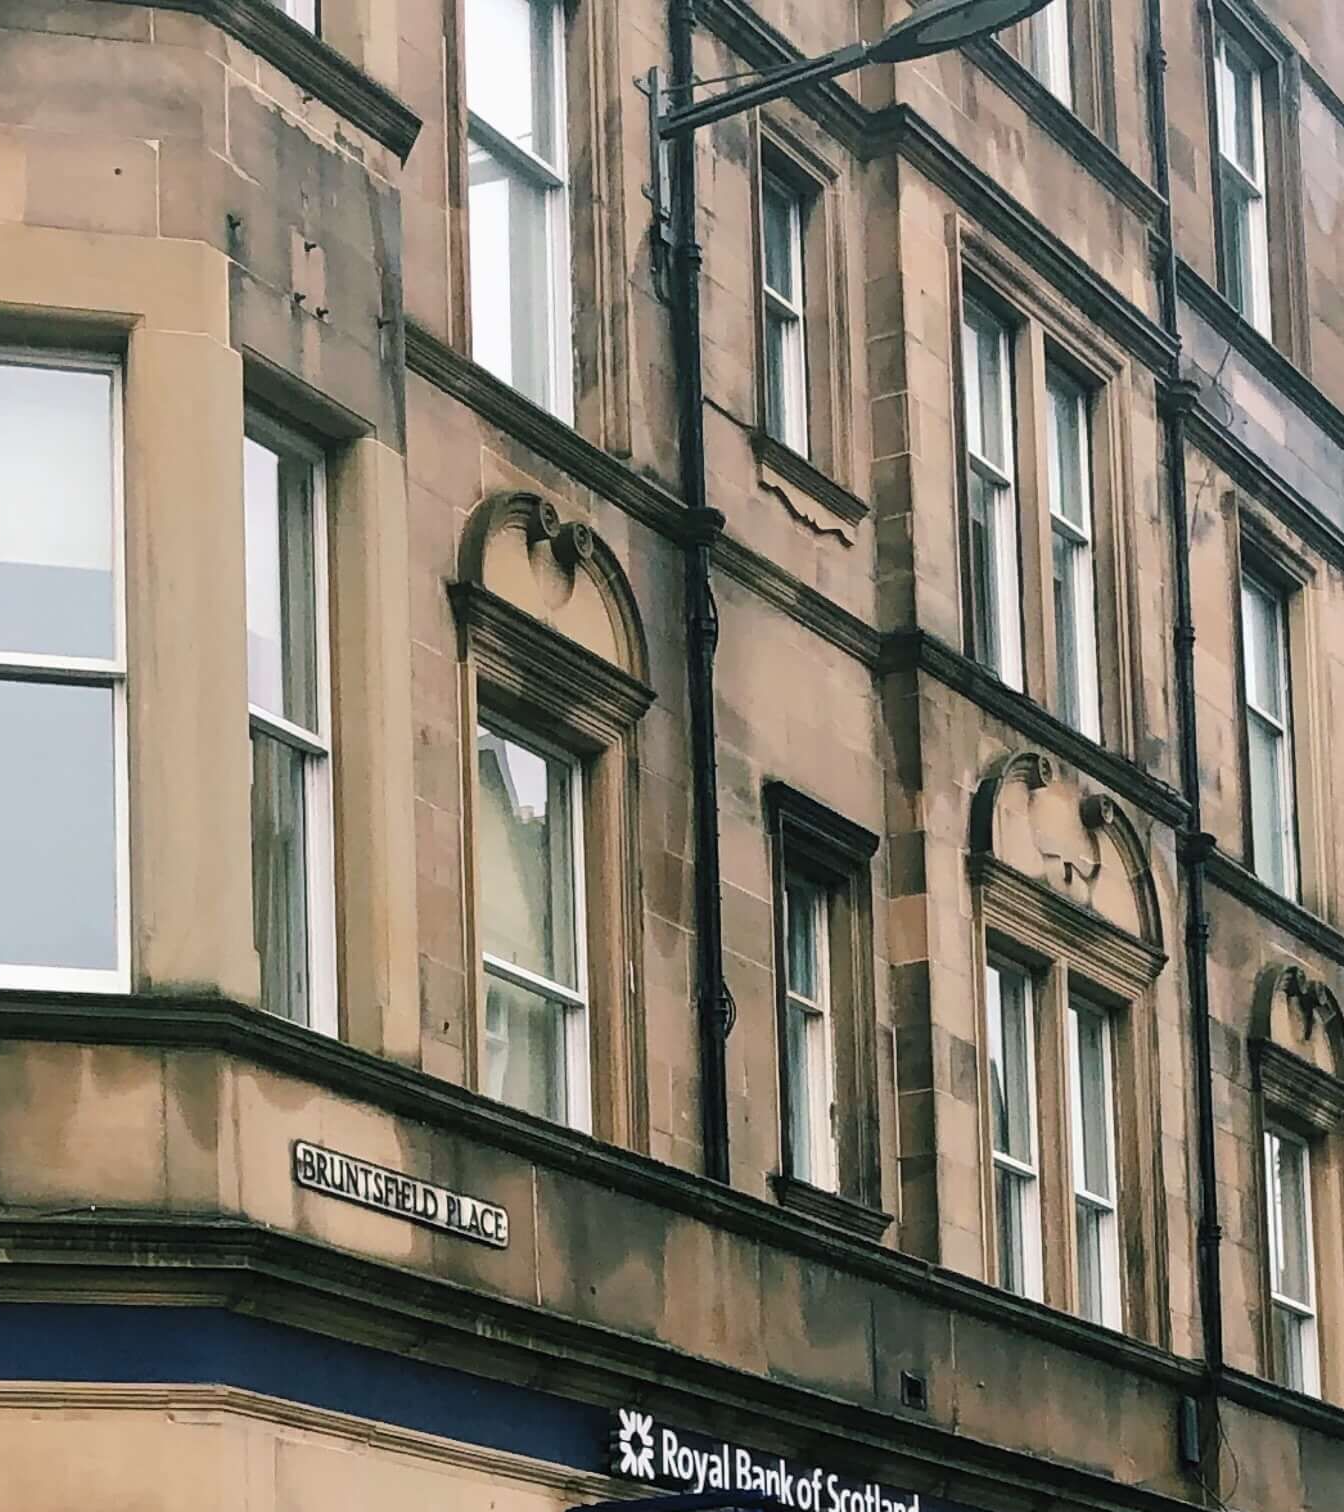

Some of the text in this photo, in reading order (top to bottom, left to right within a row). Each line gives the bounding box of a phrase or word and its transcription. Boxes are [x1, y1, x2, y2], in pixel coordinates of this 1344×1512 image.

[303, 1149, 506, 1240] BRUNTSFIELD PLACE
[662, 1429, 730, 1494] Royal
[736, 1449, 794, 1507] Bank
[797, 1469, 822, 1512] of
